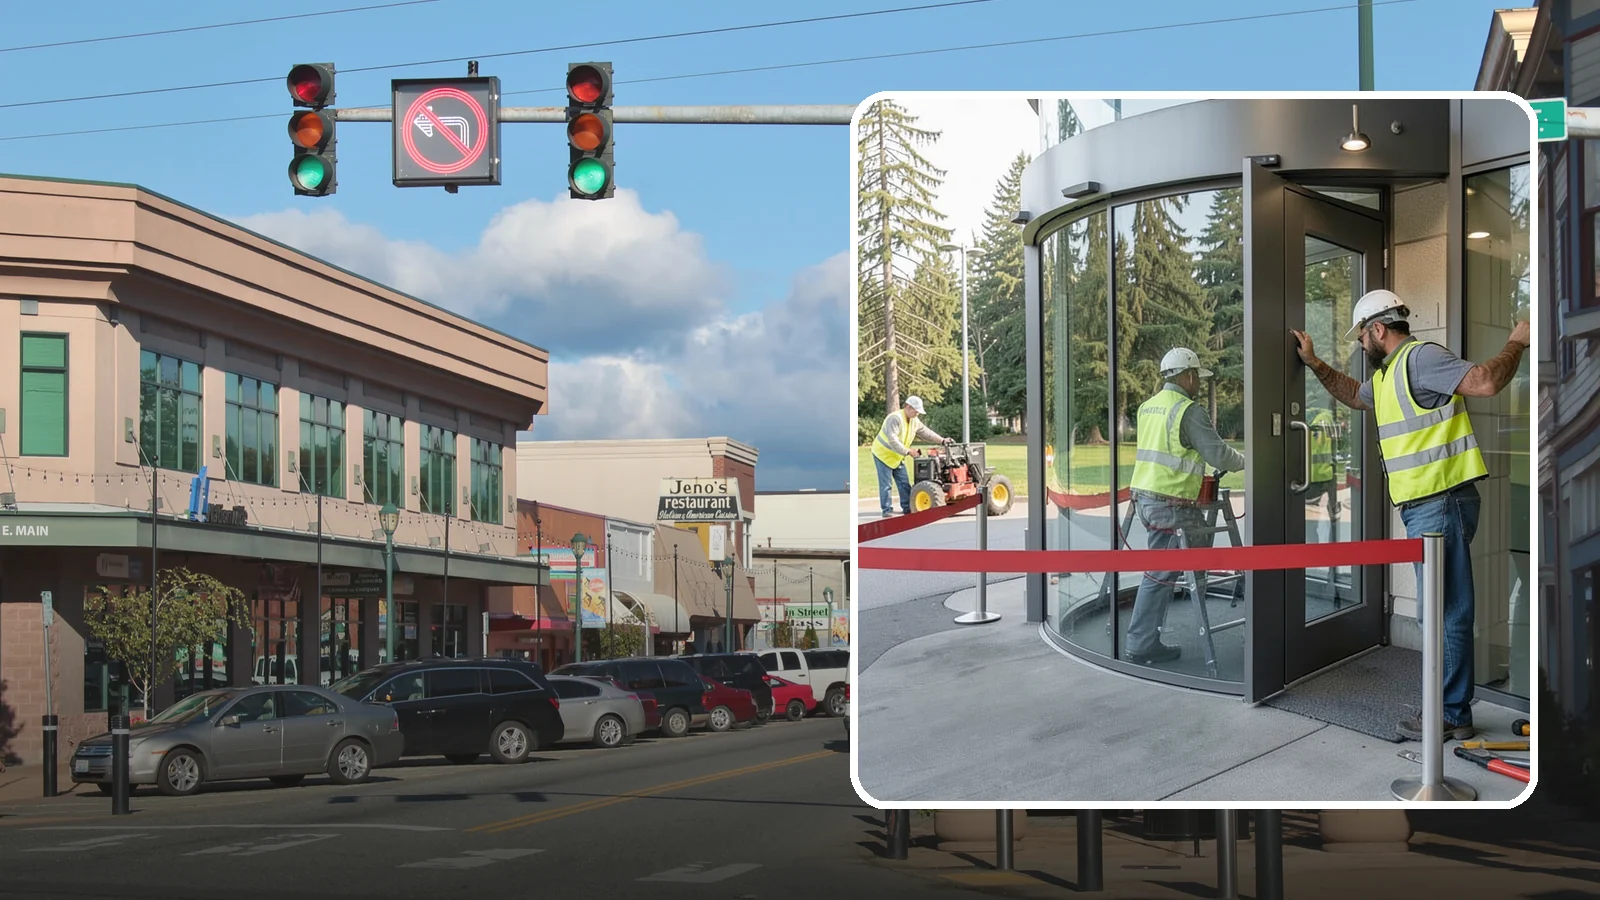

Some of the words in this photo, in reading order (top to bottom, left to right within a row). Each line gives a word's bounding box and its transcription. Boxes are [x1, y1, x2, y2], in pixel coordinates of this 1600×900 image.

[670, 480, 727, 494] Jeno's
[665, 496, 731, 509] restaurant
[686, 509, 714, 519] American
[715, 509, 738, 519] Cuisine
[2, 525, 13, 536] E.
[15, 525, 49, 536] MAIN
[797, 607, 829, 617] Street
